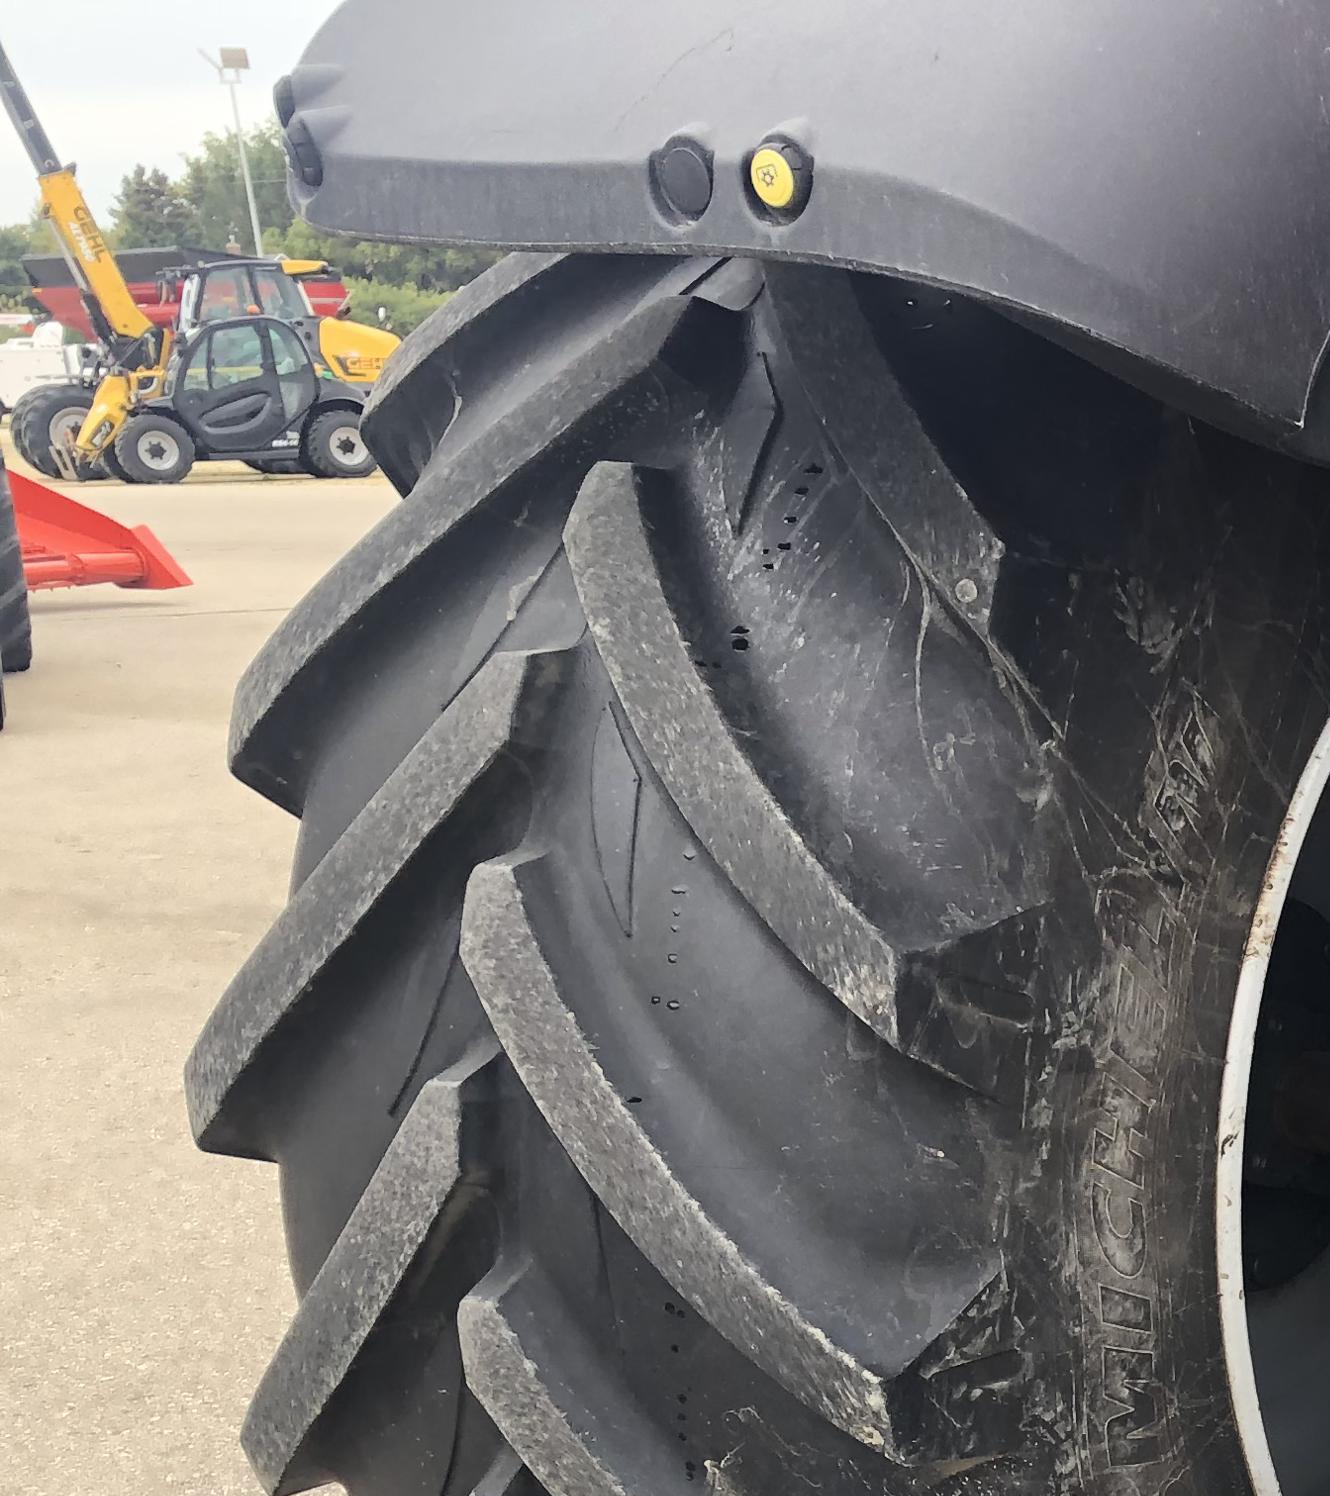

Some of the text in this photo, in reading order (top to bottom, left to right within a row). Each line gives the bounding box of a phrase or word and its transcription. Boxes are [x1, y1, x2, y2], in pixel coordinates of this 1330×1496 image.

[73, 206, 105, 264] GEHL
[346, 358, 385, 371] GEH
[1090, 683, 1218, 1470] MICHELIN
